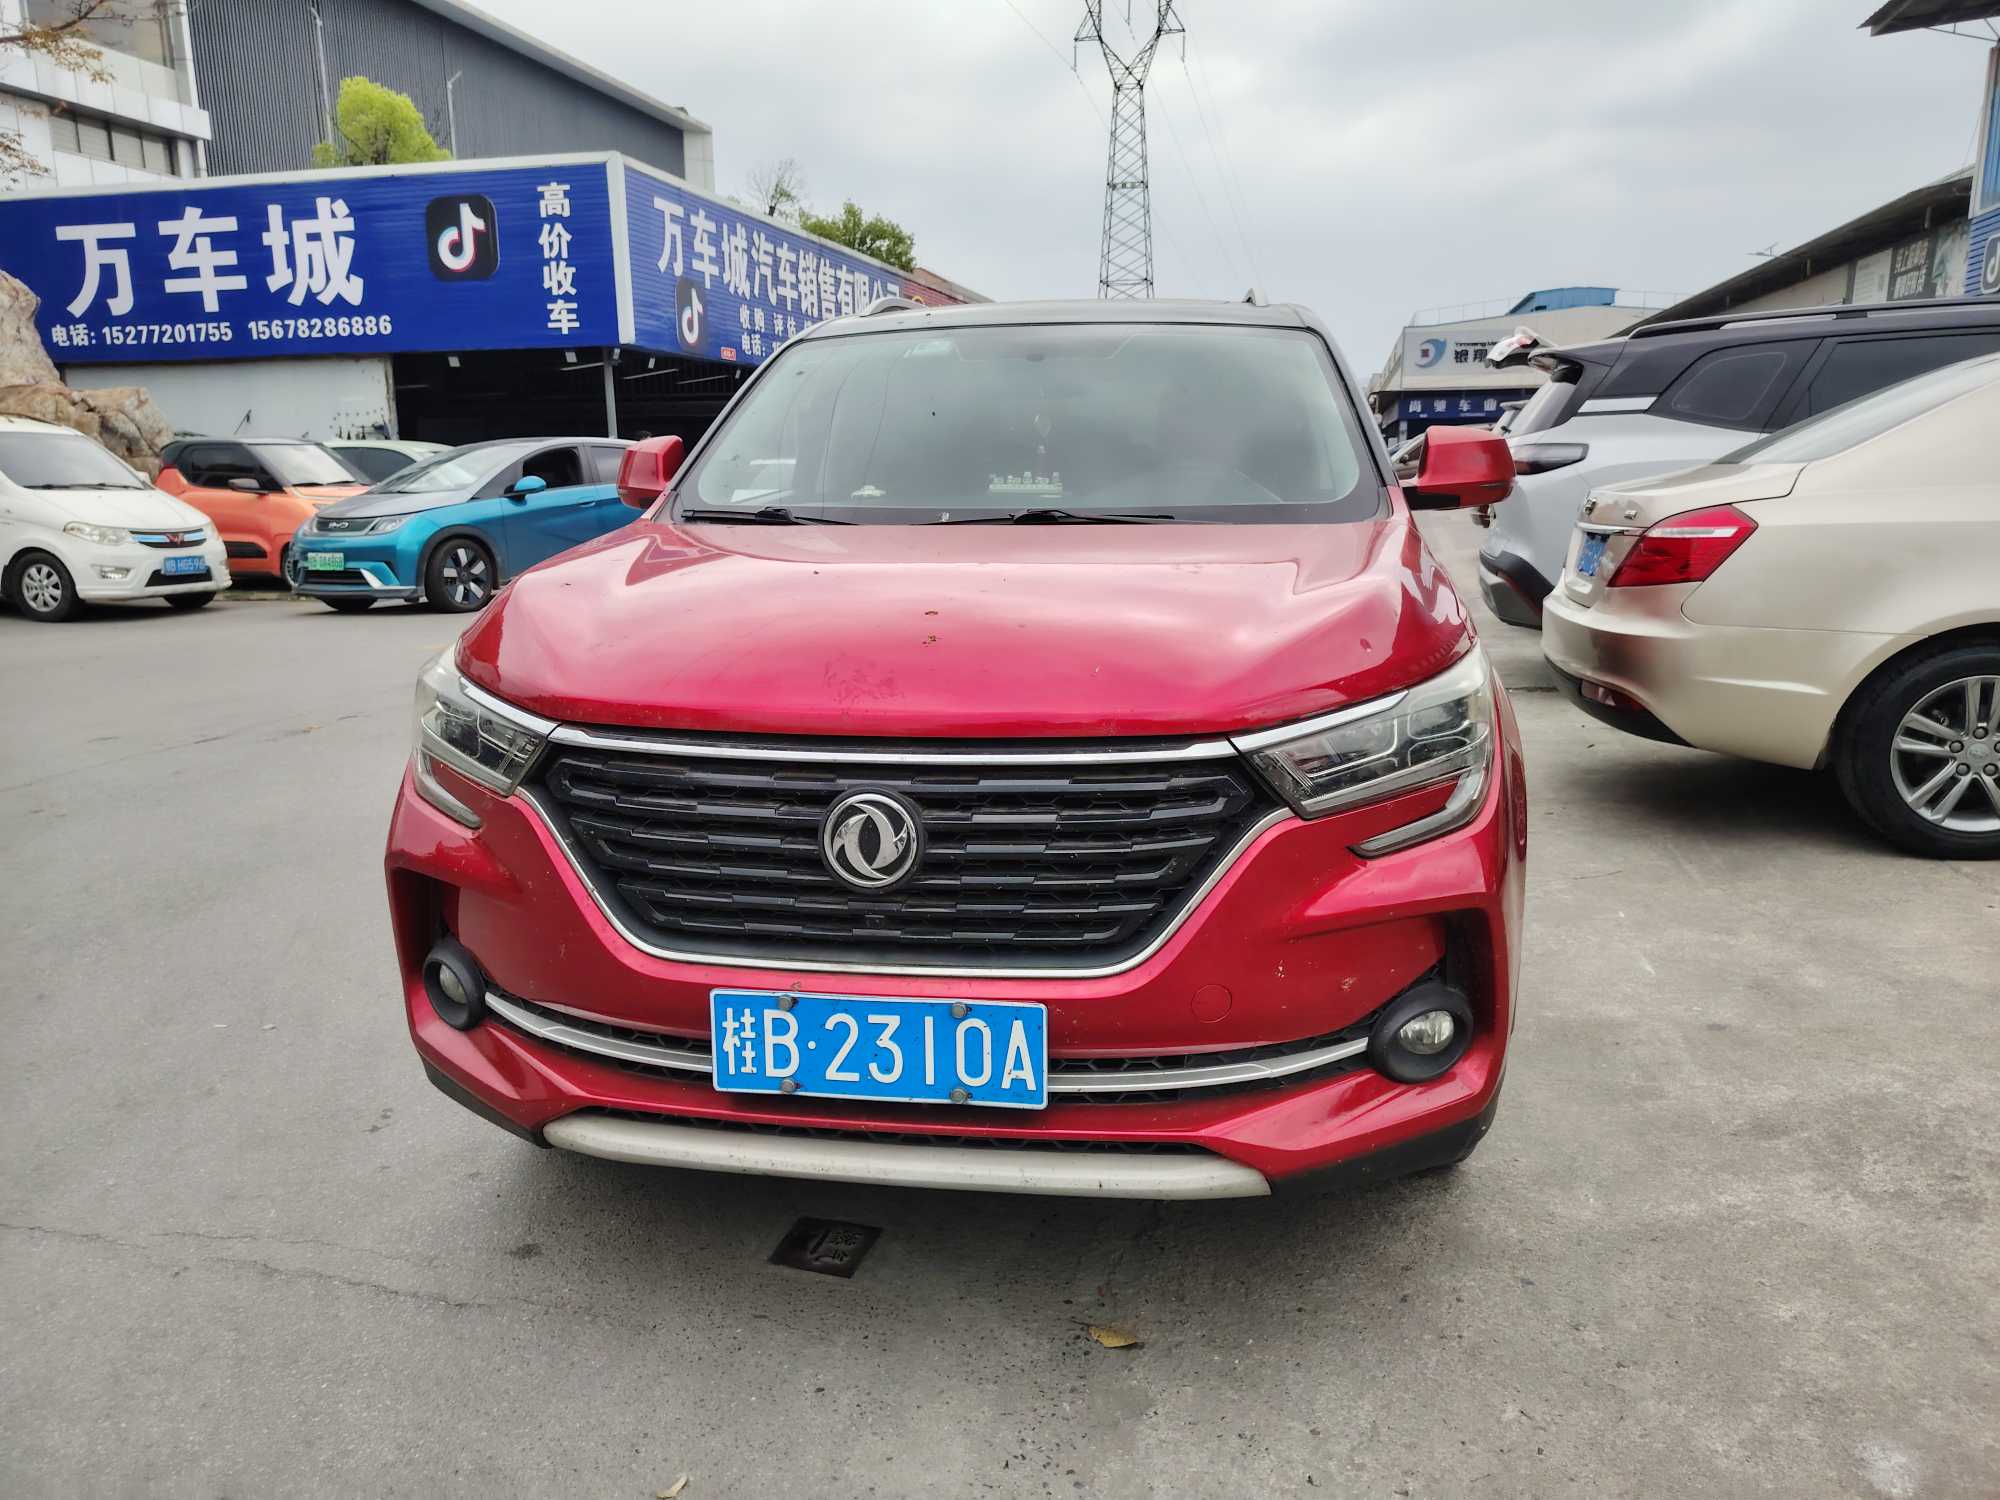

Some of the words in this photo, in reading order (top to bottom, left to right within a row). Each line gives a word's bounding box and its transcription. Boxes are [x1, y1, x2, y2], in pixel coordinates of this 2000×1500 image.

[55, 197, 364, 318] 万车城
[537, 182, 580, 335] 高价收车
[653, 196, 901, 320] 万车城汽车销售有限
[102, 321, 233, 345] 15277201755
[248, 315, 392, 340] 15678286886
